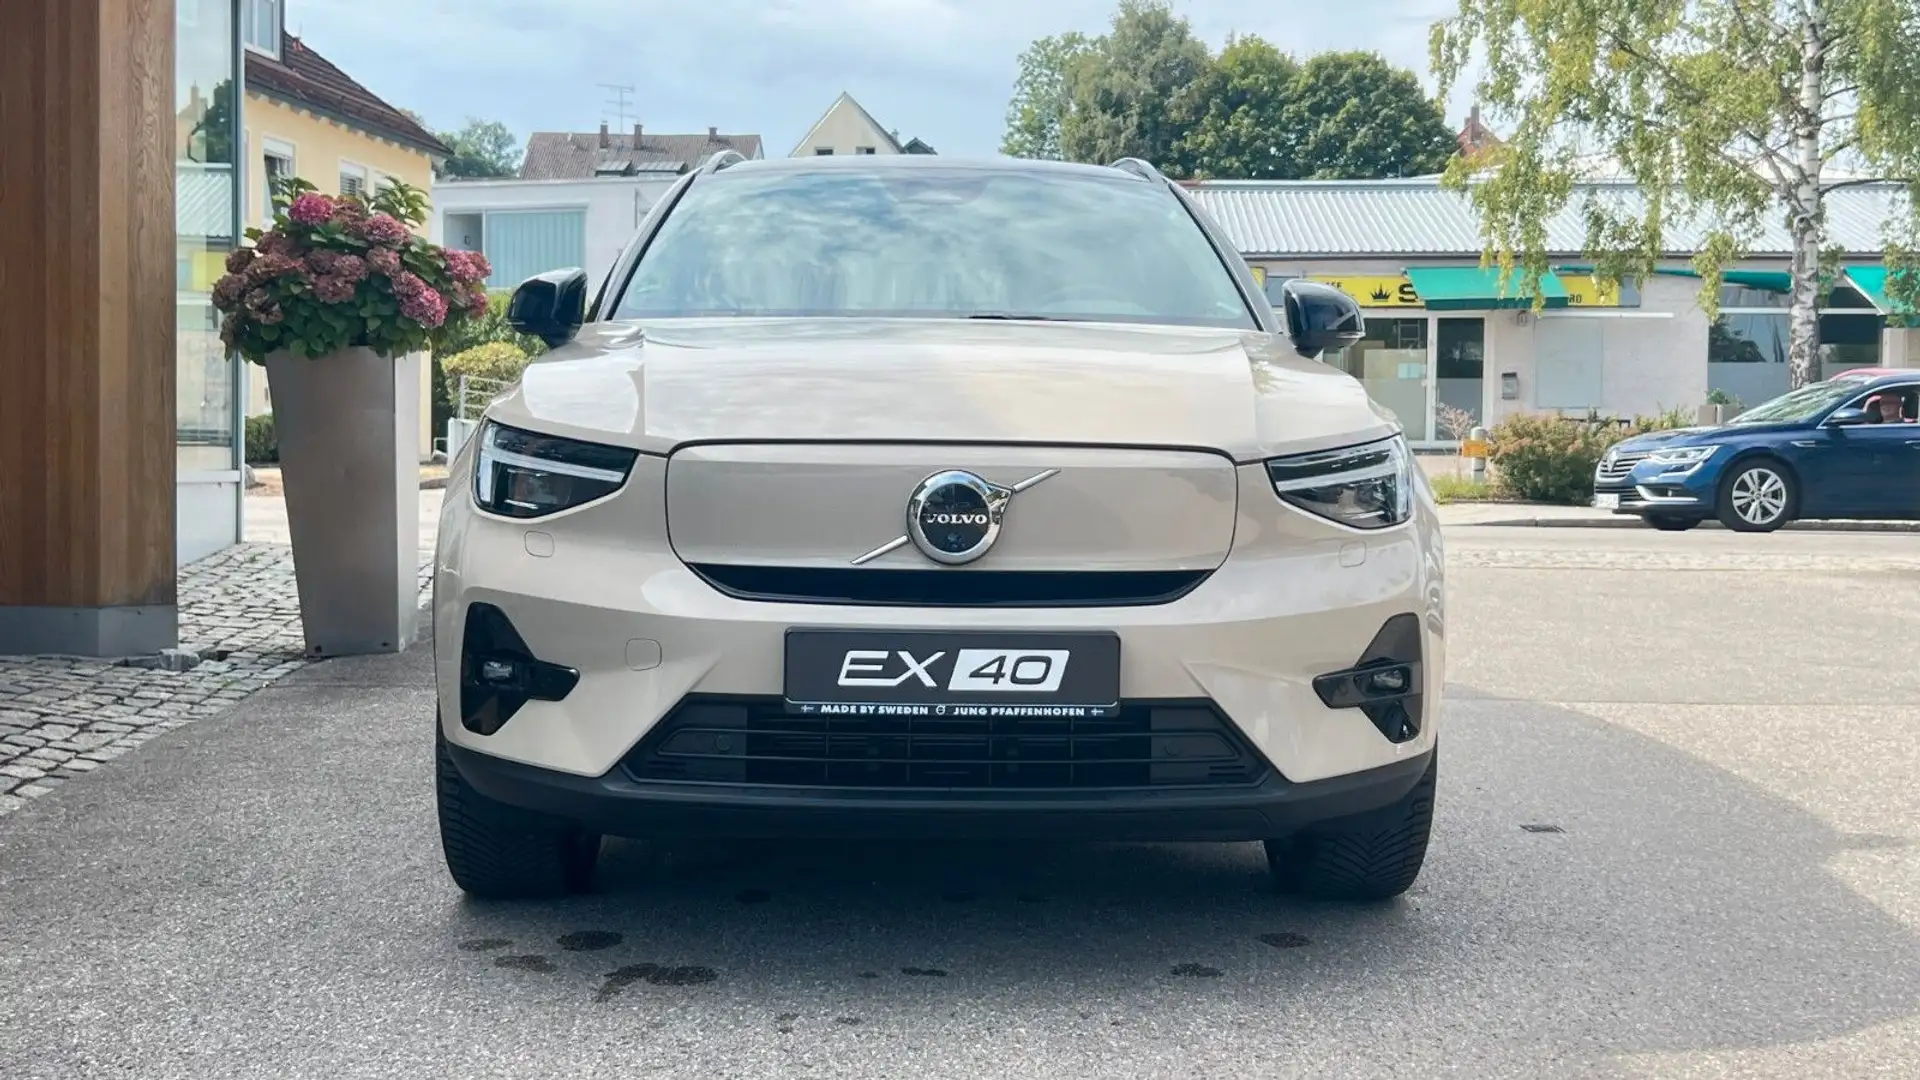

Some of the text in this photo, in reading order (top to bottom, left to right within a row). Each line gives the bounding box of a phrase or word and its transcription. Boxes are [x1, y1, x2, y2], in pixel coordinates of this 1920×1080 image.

[923, 513, 988, 525] VOLVO
[837, 650, 1053, 687] EX 40
[820, 704, 1085, 716] MADE BY SWEDEN JUNG PFAFFENHOFEN
